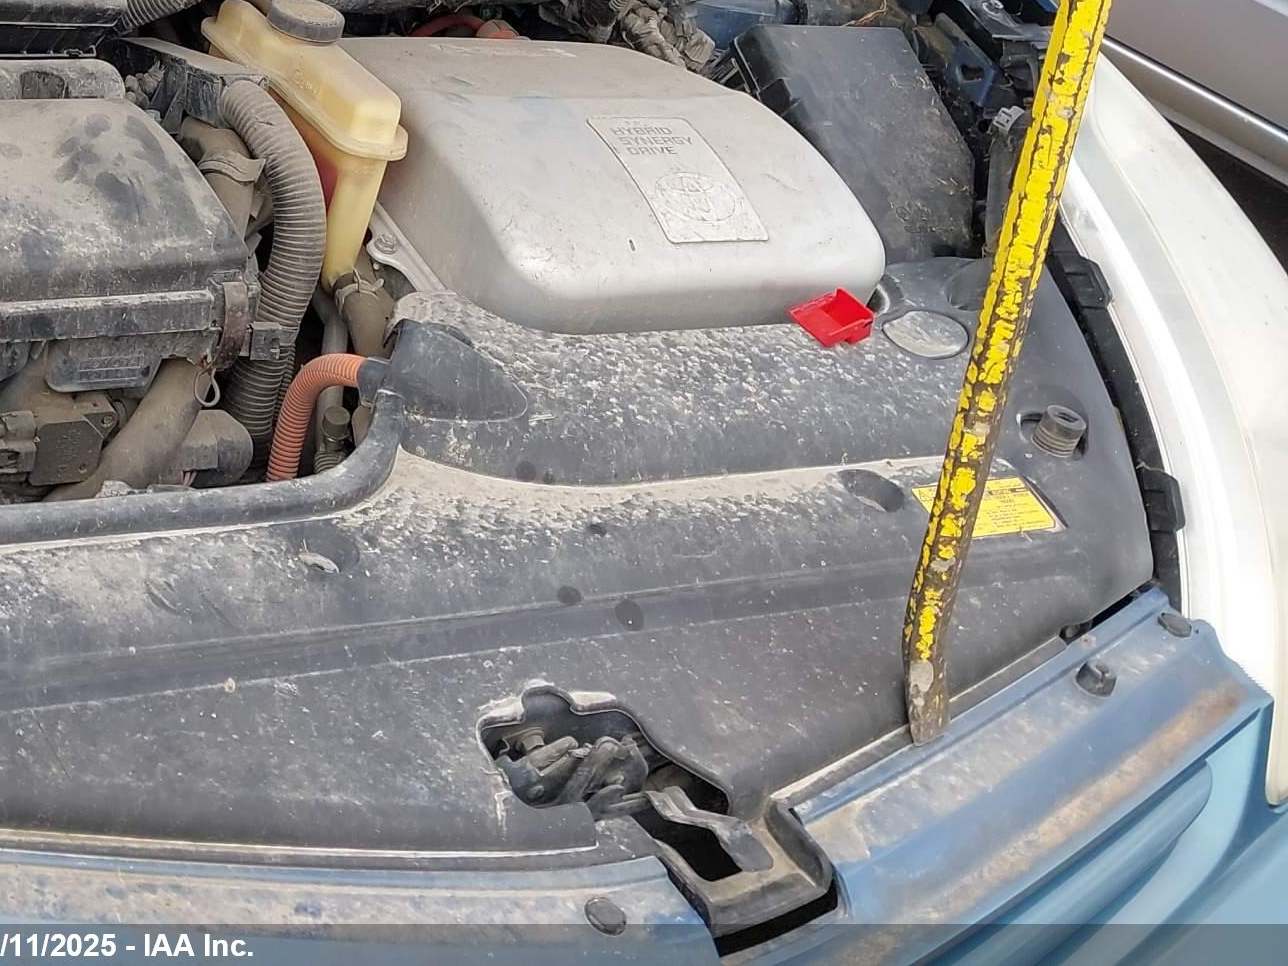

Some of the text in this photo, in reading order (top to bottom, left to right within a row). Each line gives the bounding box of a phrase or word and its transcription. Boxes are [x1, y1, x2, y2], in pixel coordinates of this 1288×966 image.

[610, 127, 673, 135] HYBRID
[618, 136, 692, 146] SYNERGY
[626, 146, 678, 155] DRIVE
